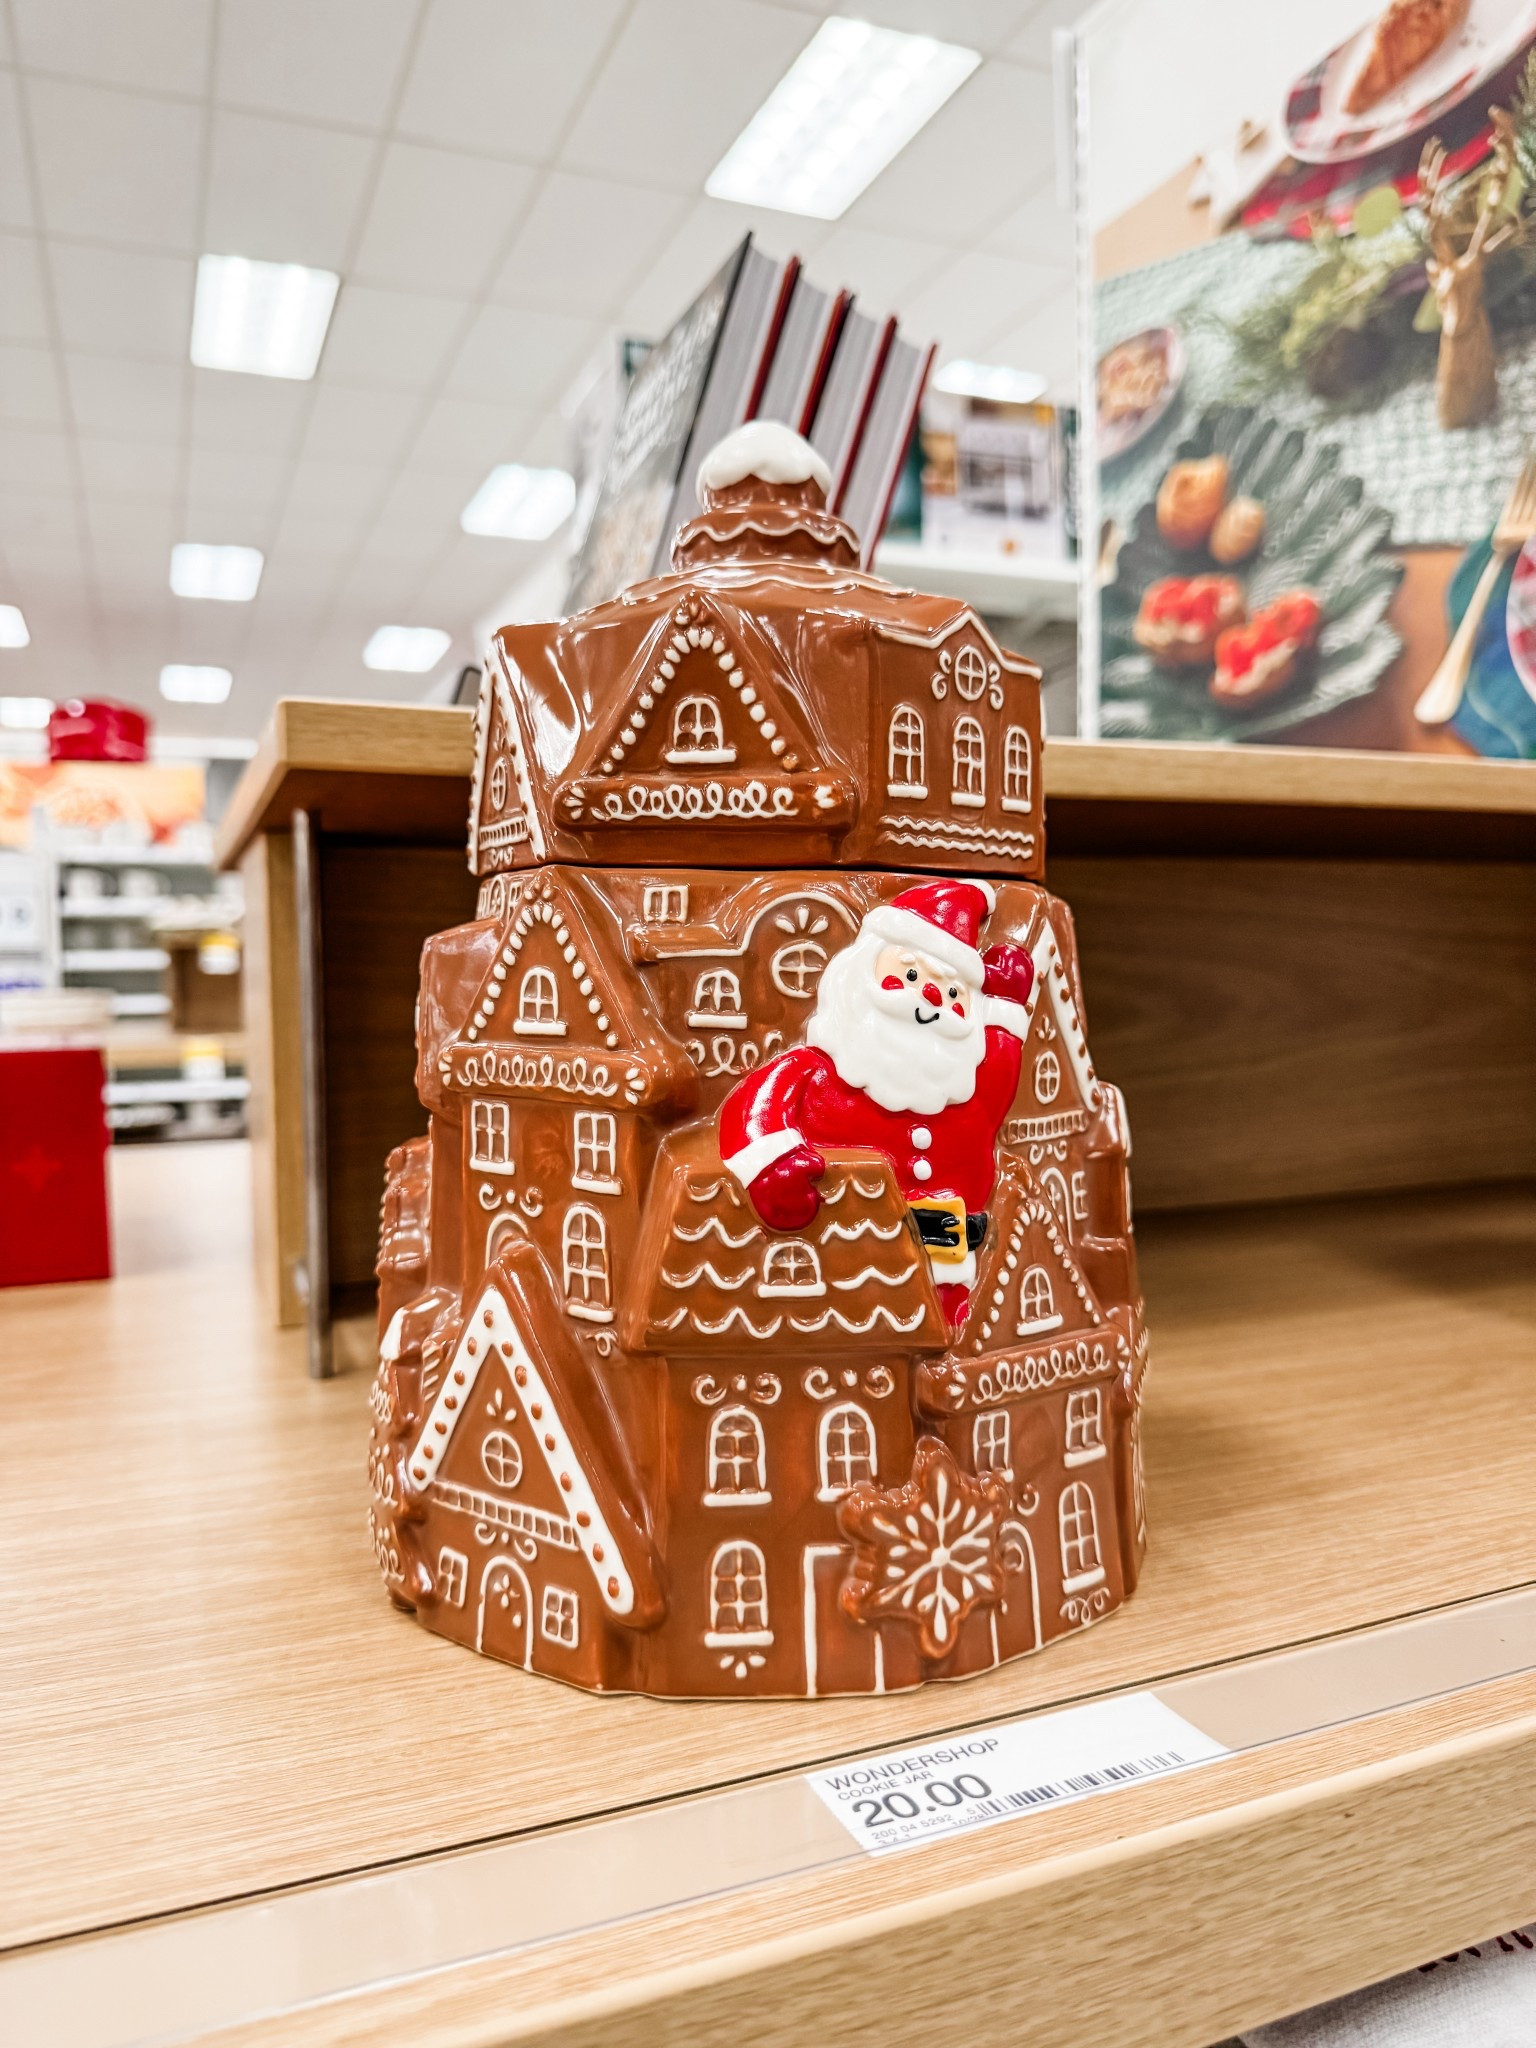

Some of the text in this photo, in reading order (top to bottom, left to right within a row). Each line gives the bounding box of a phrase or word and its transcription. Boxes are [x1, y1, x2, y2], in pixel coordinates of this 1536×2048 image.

[825, 1738, 999, 1790] WONDERSHOP
[838, 1771, 935, 1801] COOKIE JAR
[852, 1774, 992, 1828] 20.00
[871, 1828, 898, 1840] 200
